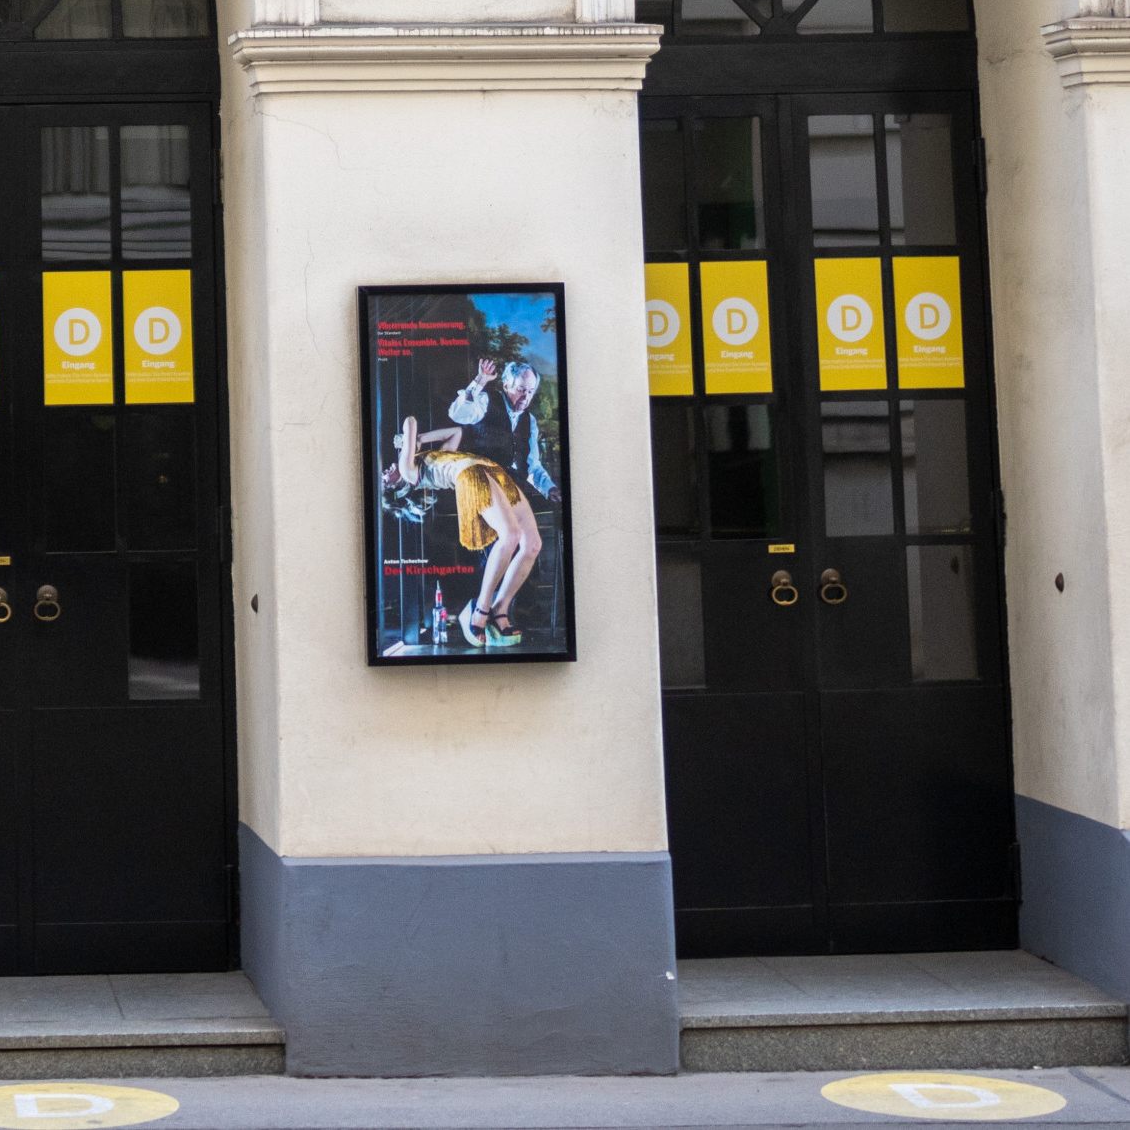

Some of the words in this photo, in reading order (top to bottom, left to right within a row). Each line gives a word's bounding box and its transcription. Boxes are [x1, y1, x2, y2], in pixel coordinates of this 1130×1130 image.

[647, 311, 669, 337] D
[727, 308, 748, 334] D
[841, 305, 862, 331] D
[919, 304, 940, 330] D
[68, 318, 91, 346] D
[148, 317, 170, 345] D
[721, 351, 754, 359] Eingang
[835, 347, 868, 355] Eingang
[913, 345, 946, 354] Eingang
[61, 361, 95, 370] Eingang
[142, 360, 175, 369] Eingang
[384, 566, 402, 575] Der
[405, 565, 475, 576] Kirschgarten
[13, 1093, 115, 1118] D
[888, 1083, 1000, 1108] D
